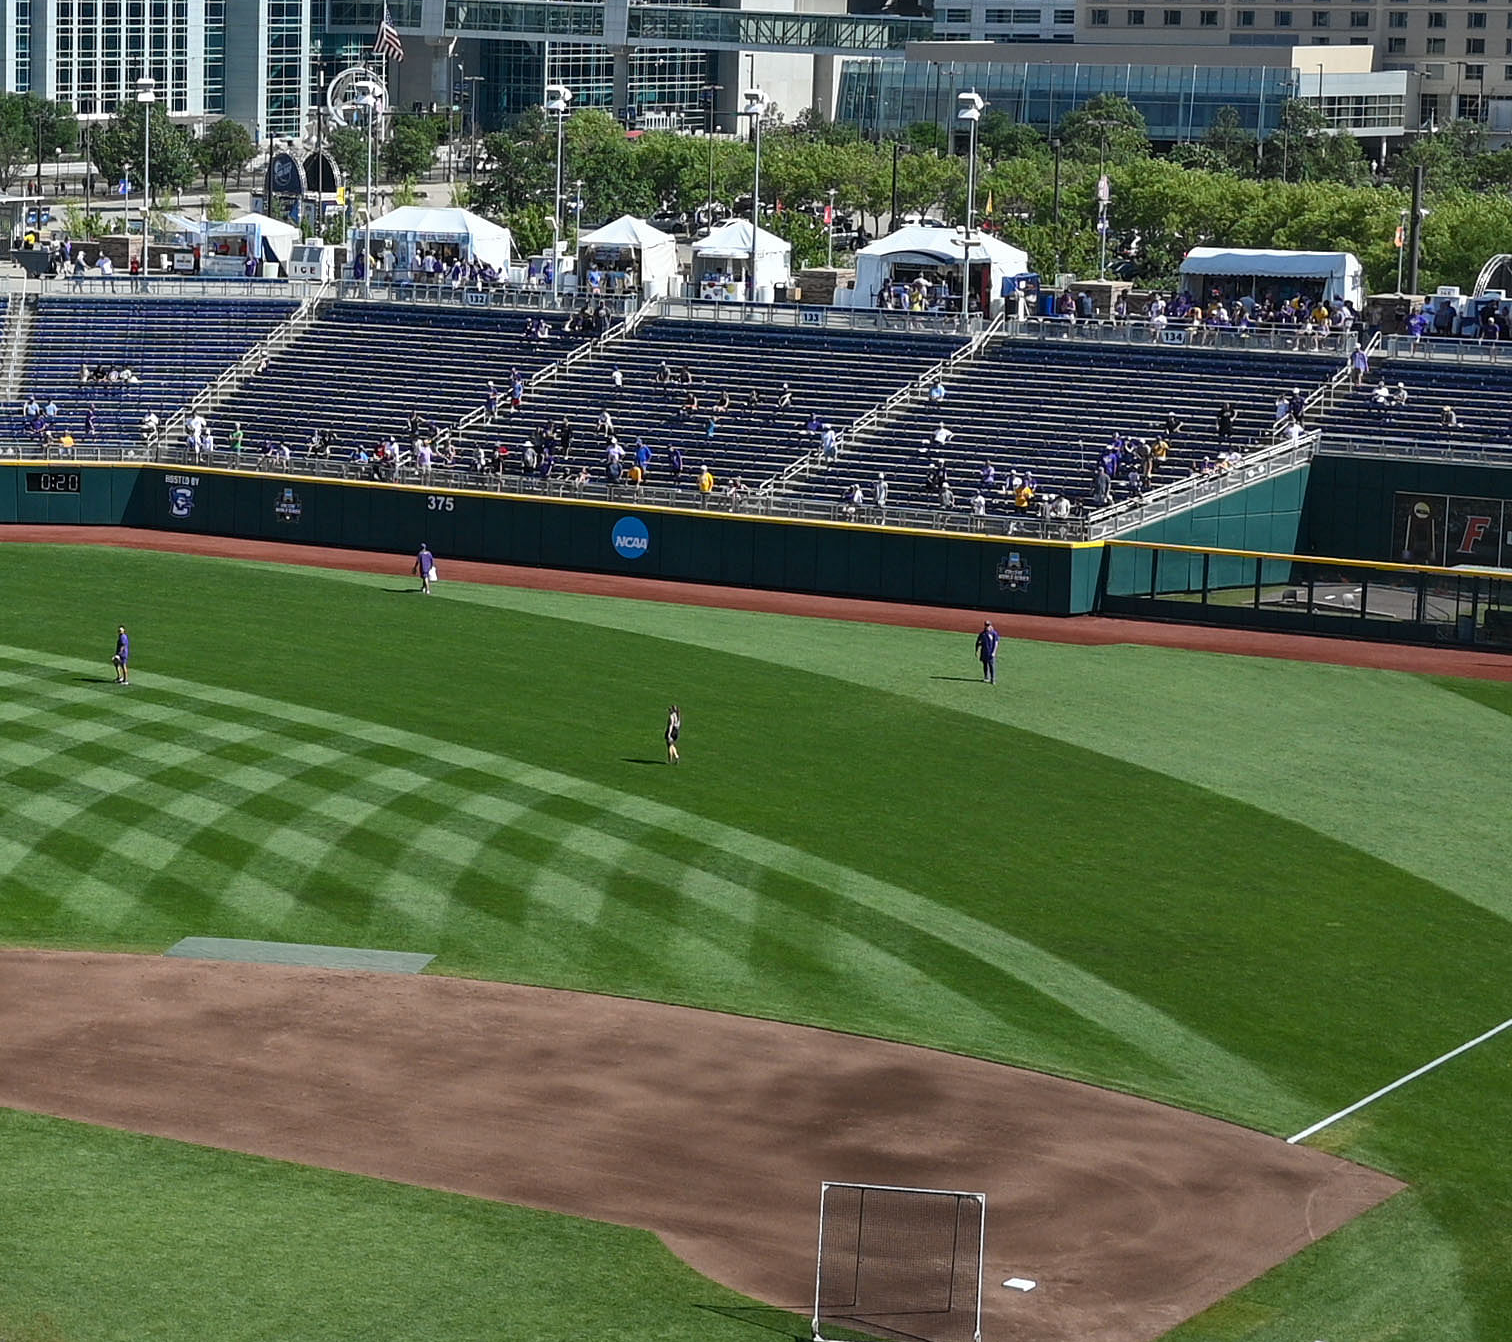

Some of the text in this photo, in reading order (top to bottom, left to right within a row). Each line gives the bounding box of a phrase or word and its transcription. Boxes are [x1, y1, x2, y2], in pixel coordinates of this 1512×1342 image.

[292, 265, 317, 275] ICE
[804, 313, 819, 322] 133
[1165, 333, 1182, 341] 134
[41, 474, 78, 491] 0:20
[427, 495, 455, 512] 375
[1456, 515, 1491, 554] F
[615, 536, 648, 550] NCAA
